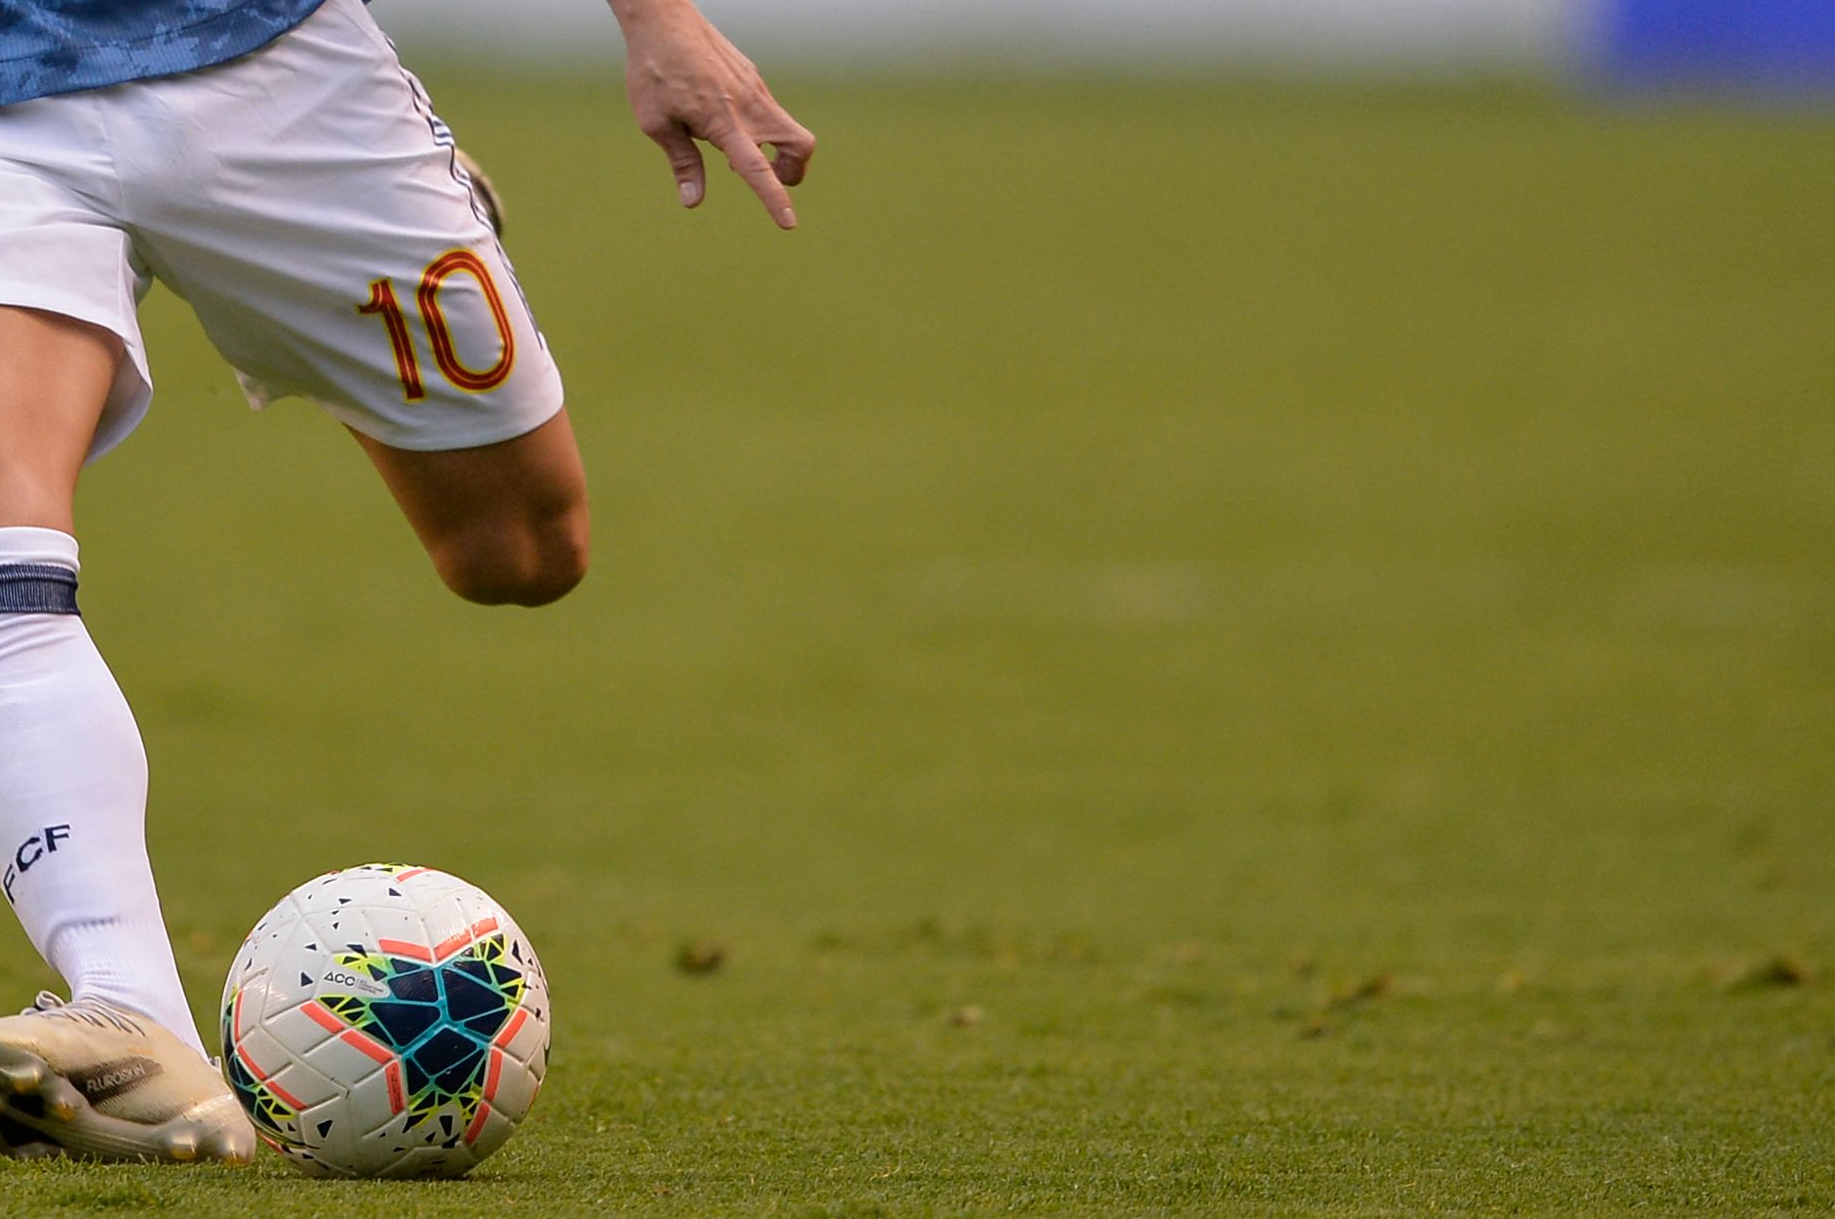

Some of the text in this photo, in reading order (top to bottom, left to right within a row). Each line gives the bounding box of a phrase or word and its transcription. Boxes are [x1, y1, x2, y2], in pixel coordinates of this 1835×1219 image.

[356, 246, 516, 404] 10
[3, 824, 71, 905] FCF
[324, 971, 356, 986] ACC
